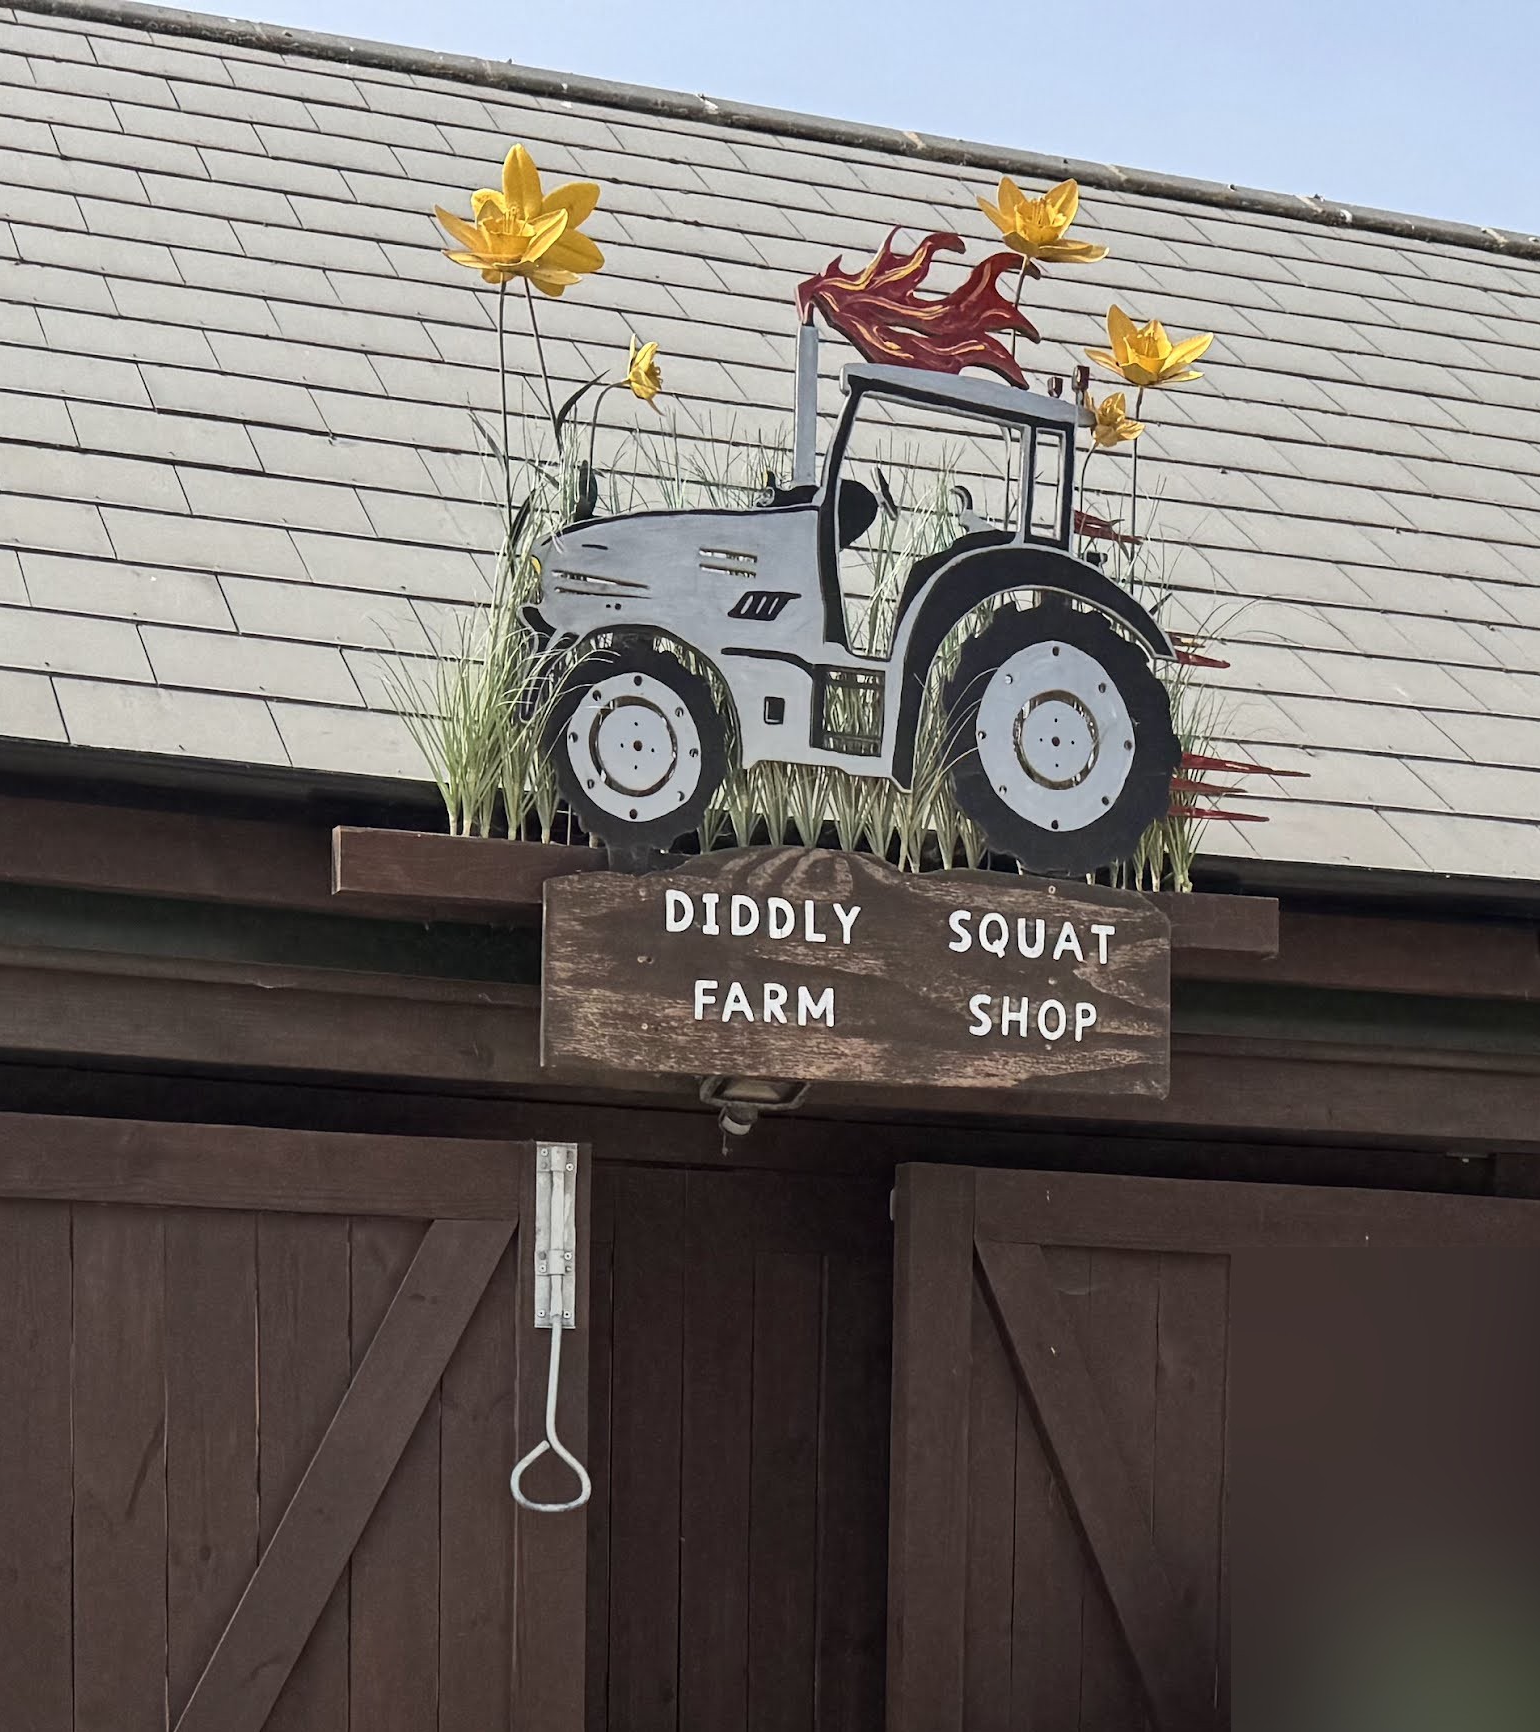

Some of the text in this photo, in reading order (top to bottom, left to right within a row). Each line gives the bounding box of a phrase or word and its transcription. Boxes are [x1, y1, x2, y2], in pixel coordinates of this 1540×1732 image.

[664, 888, 1117, 966] DIDDLY SQUAT
[693, 978, 1098, 1044] FARM SHOP
